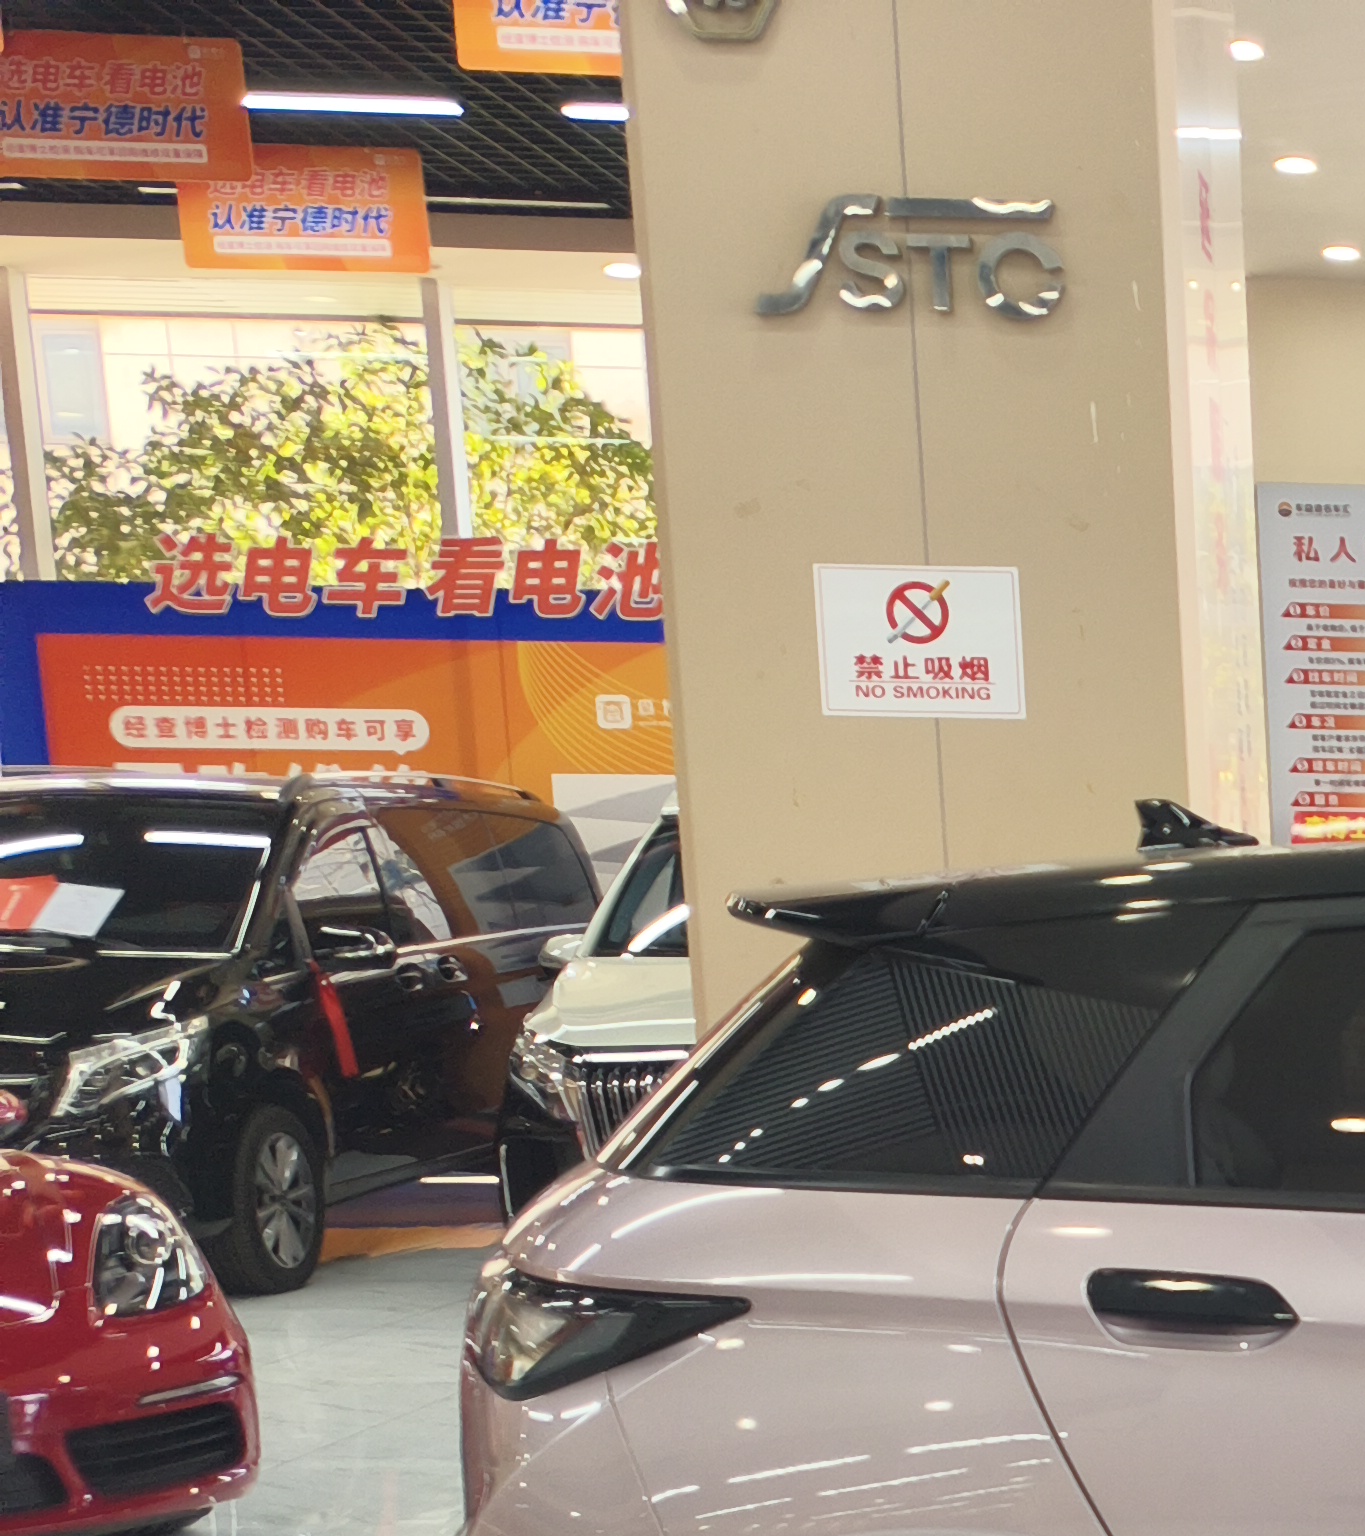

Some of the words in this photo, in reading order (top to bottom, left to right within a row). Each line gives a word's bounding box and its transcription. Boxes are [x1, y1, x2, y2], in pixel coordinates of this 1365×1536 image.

[494, 0, 620, 23] 认准宁
[0, 99, 207, 138] 认准宁德时代
[209, 203, 391, 235] 认准宁德时代
[143, 532, 664, 622] 选电车看电池
[853, 653, 991, 684] 禁止吸烟
[854, 684, 886, 701] NO
[892, 685, 992, 701] SMOKING
[121, 714, 418, 743] 经查博士检测购车可享
